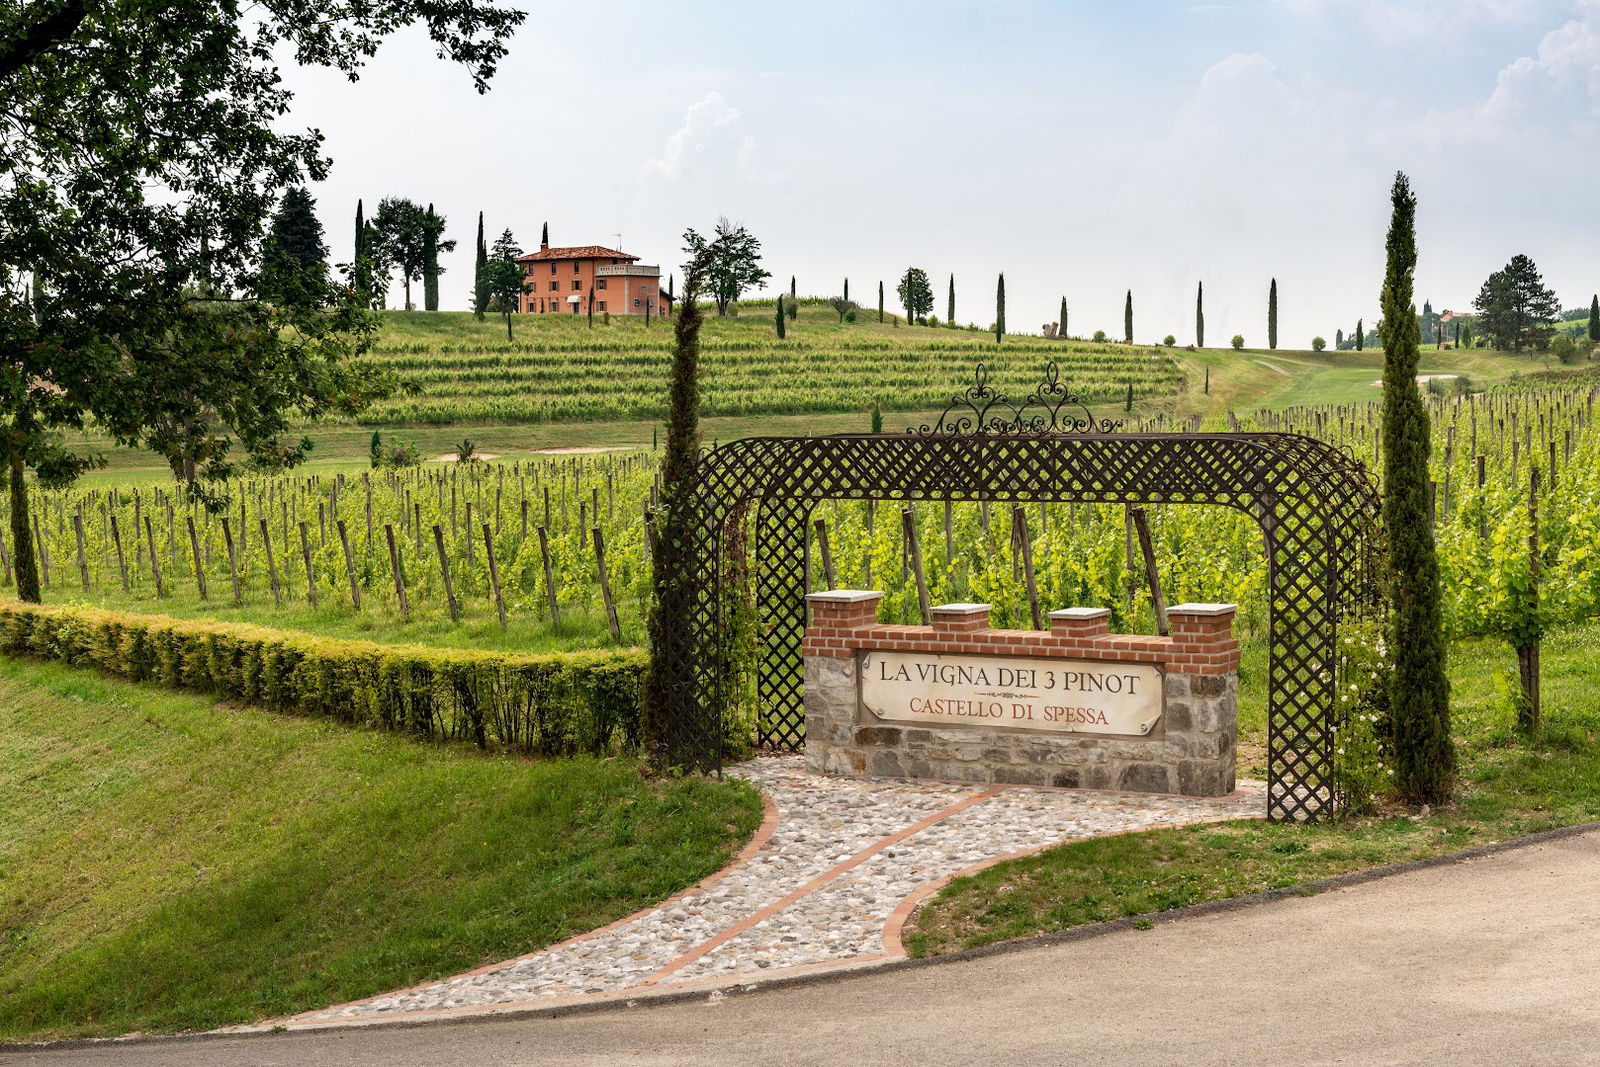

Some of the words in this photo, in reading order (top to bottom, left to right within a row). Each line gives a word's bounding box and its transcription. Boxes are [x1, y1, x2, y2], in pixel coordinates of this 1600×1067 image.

[879, 661, 912, 682] LA
[915, 663, 993, 687] VIGNA
[998, 668, 1037, 689] DEI
[1043, 671, 1056, 690] 3
[1063, 671, 1141, 695] PINOT
[909, 697, 1003, 718] CASTELLO
[1012, 703, 1033, 720] DI
[1043, 705, 1109, 725] SPESSA
